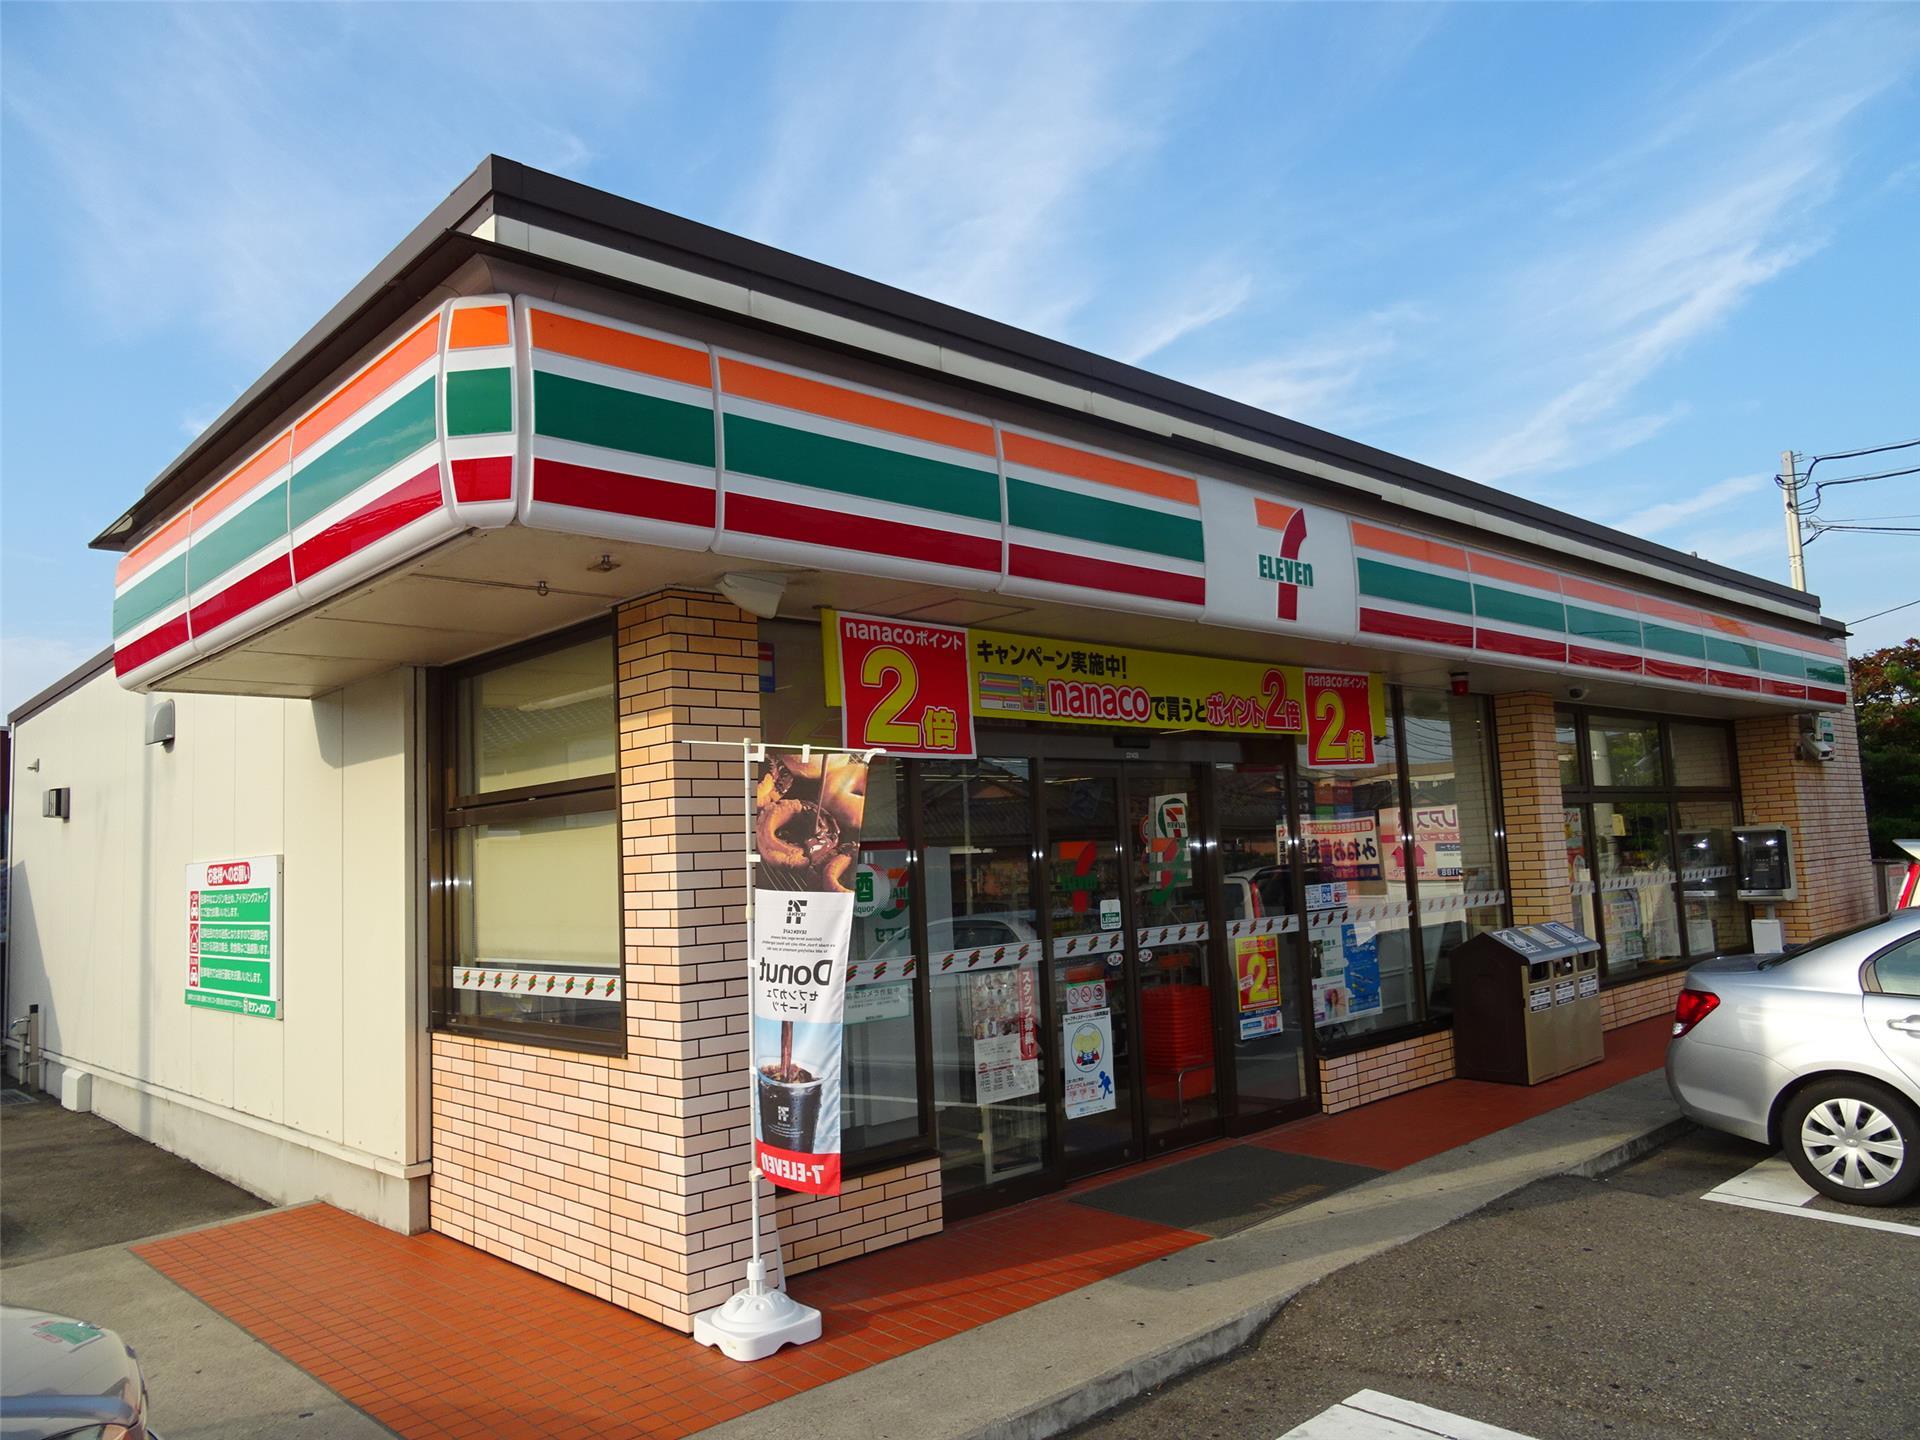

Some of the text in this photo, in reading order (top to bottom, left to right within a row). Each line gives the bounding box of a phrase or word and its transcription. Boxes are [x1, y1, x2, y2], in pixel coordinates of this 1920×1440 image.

[845, 621, 963, 651] nanacoポイント
[860, 644, 958, 751] 2倍
